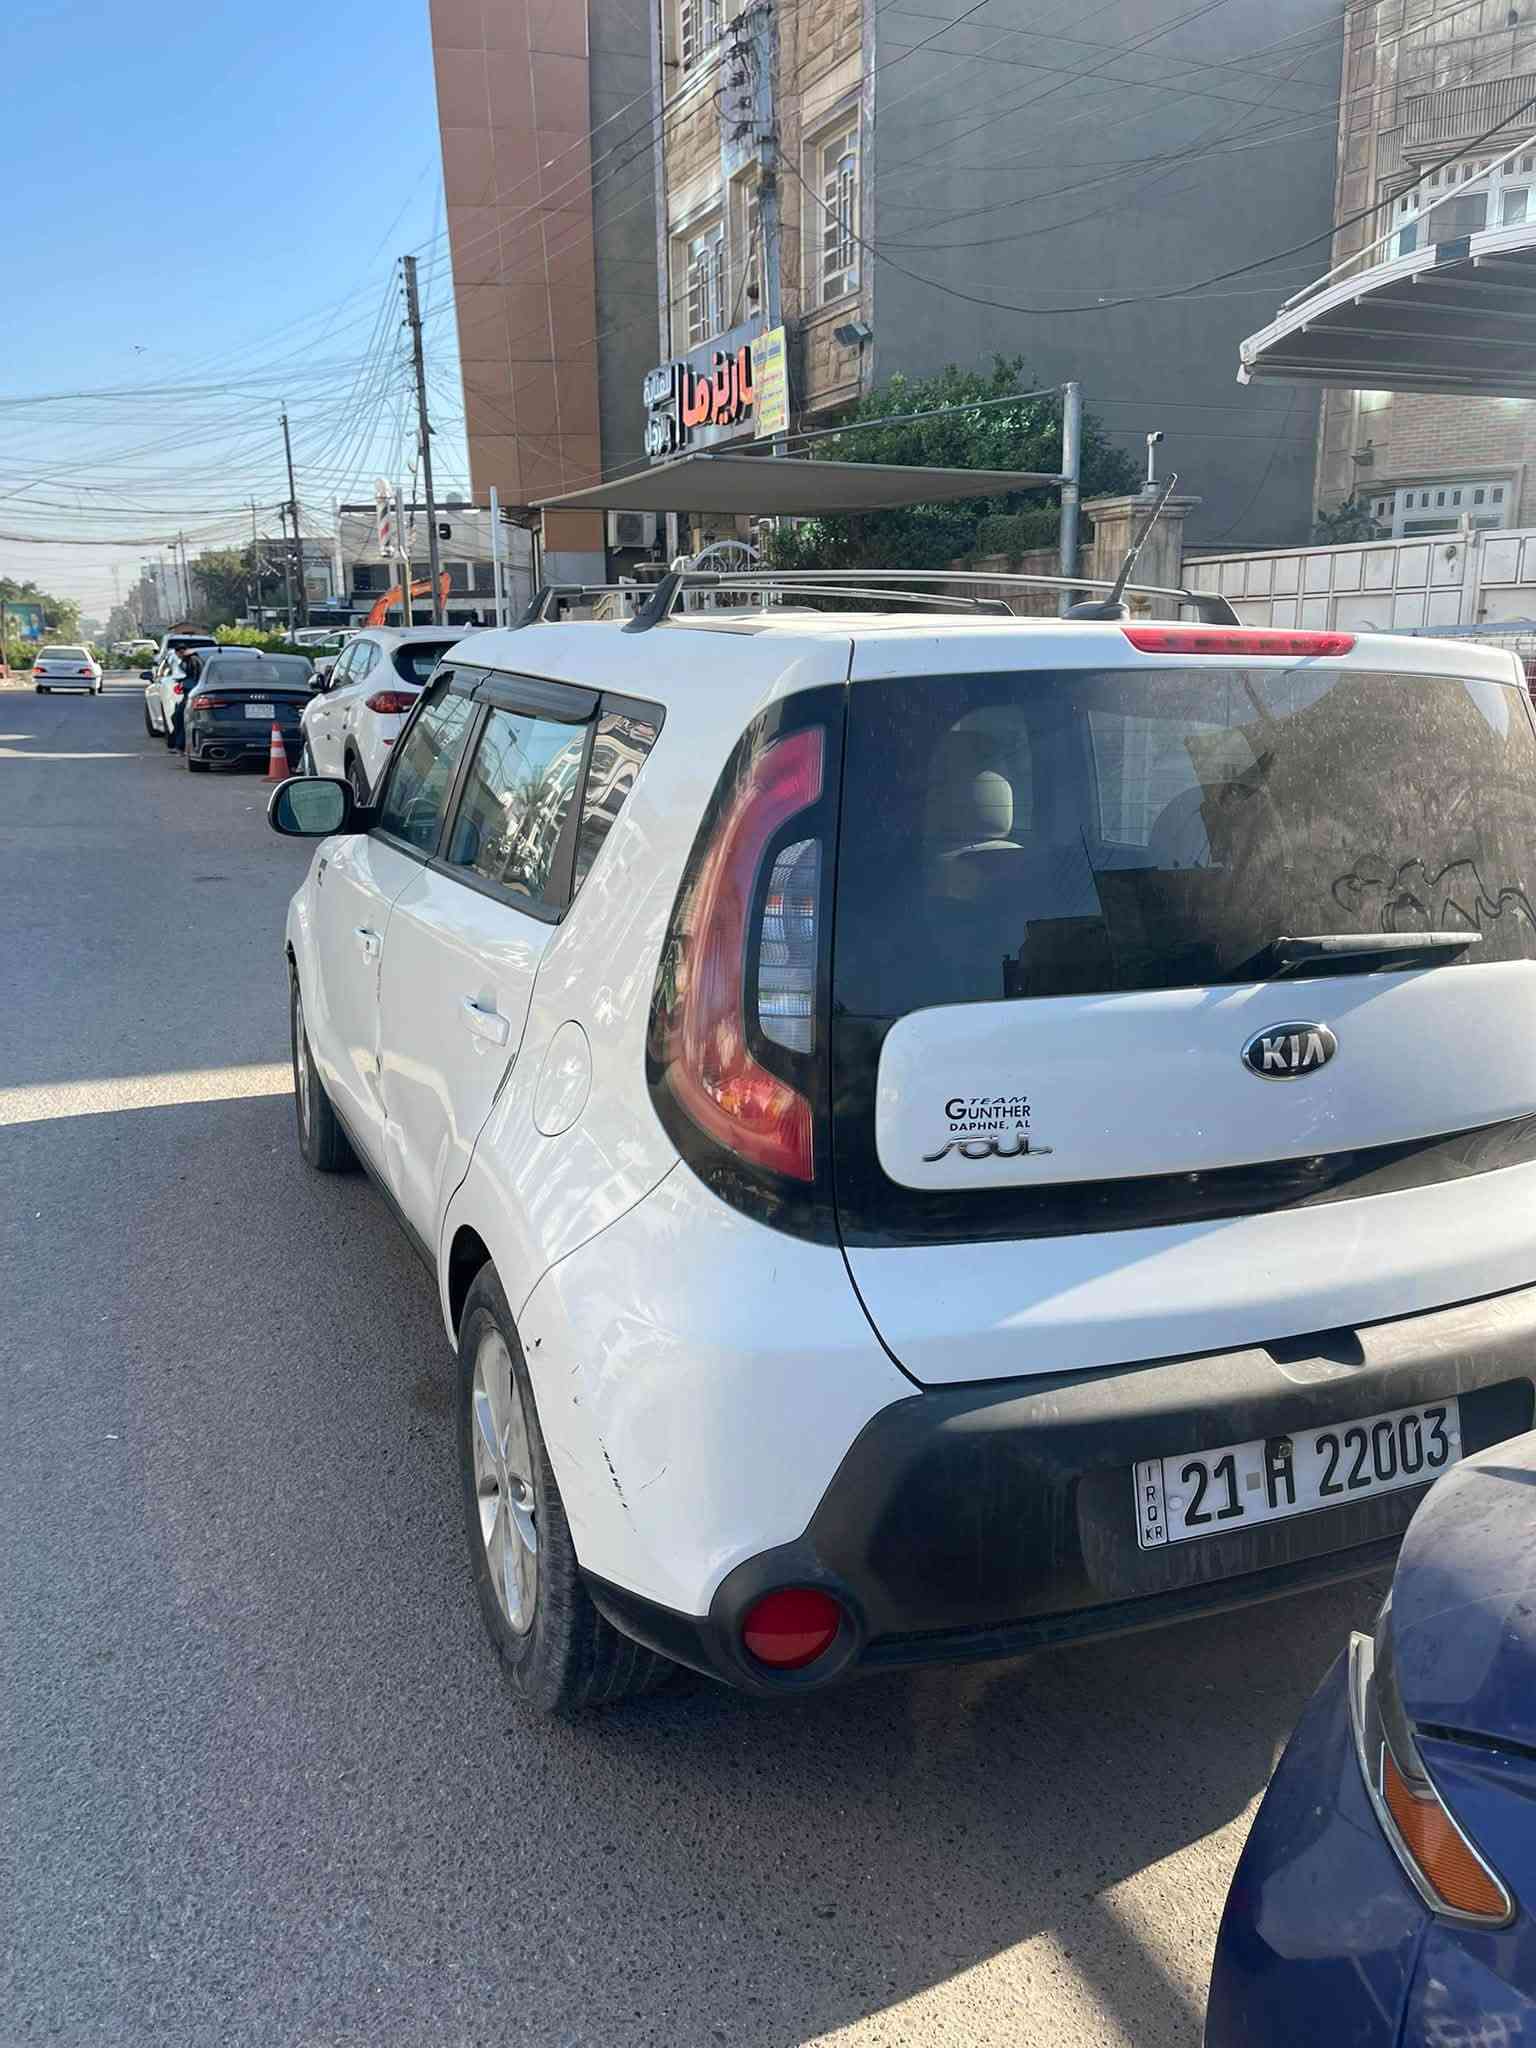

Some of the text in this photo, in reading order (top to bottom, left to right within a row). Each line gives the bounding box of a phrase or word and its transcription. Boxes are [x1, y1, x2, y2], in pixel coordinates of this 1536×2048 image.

[682, 345, 752, 428] اريزما
[1261, 1033, 1325, 1069] KIA
[945, 1098, 1031, 1120] GUNTHER
[969, 1096, 1028, 1105] TEAM
[950, 1120, 1031, 1132] DAPHNE, AL
[1181, 1454, 1244, 1526] 21
[1316, 1407, 1449, 1497] 22003
[1145, 1525, 1164, 1542] KR
